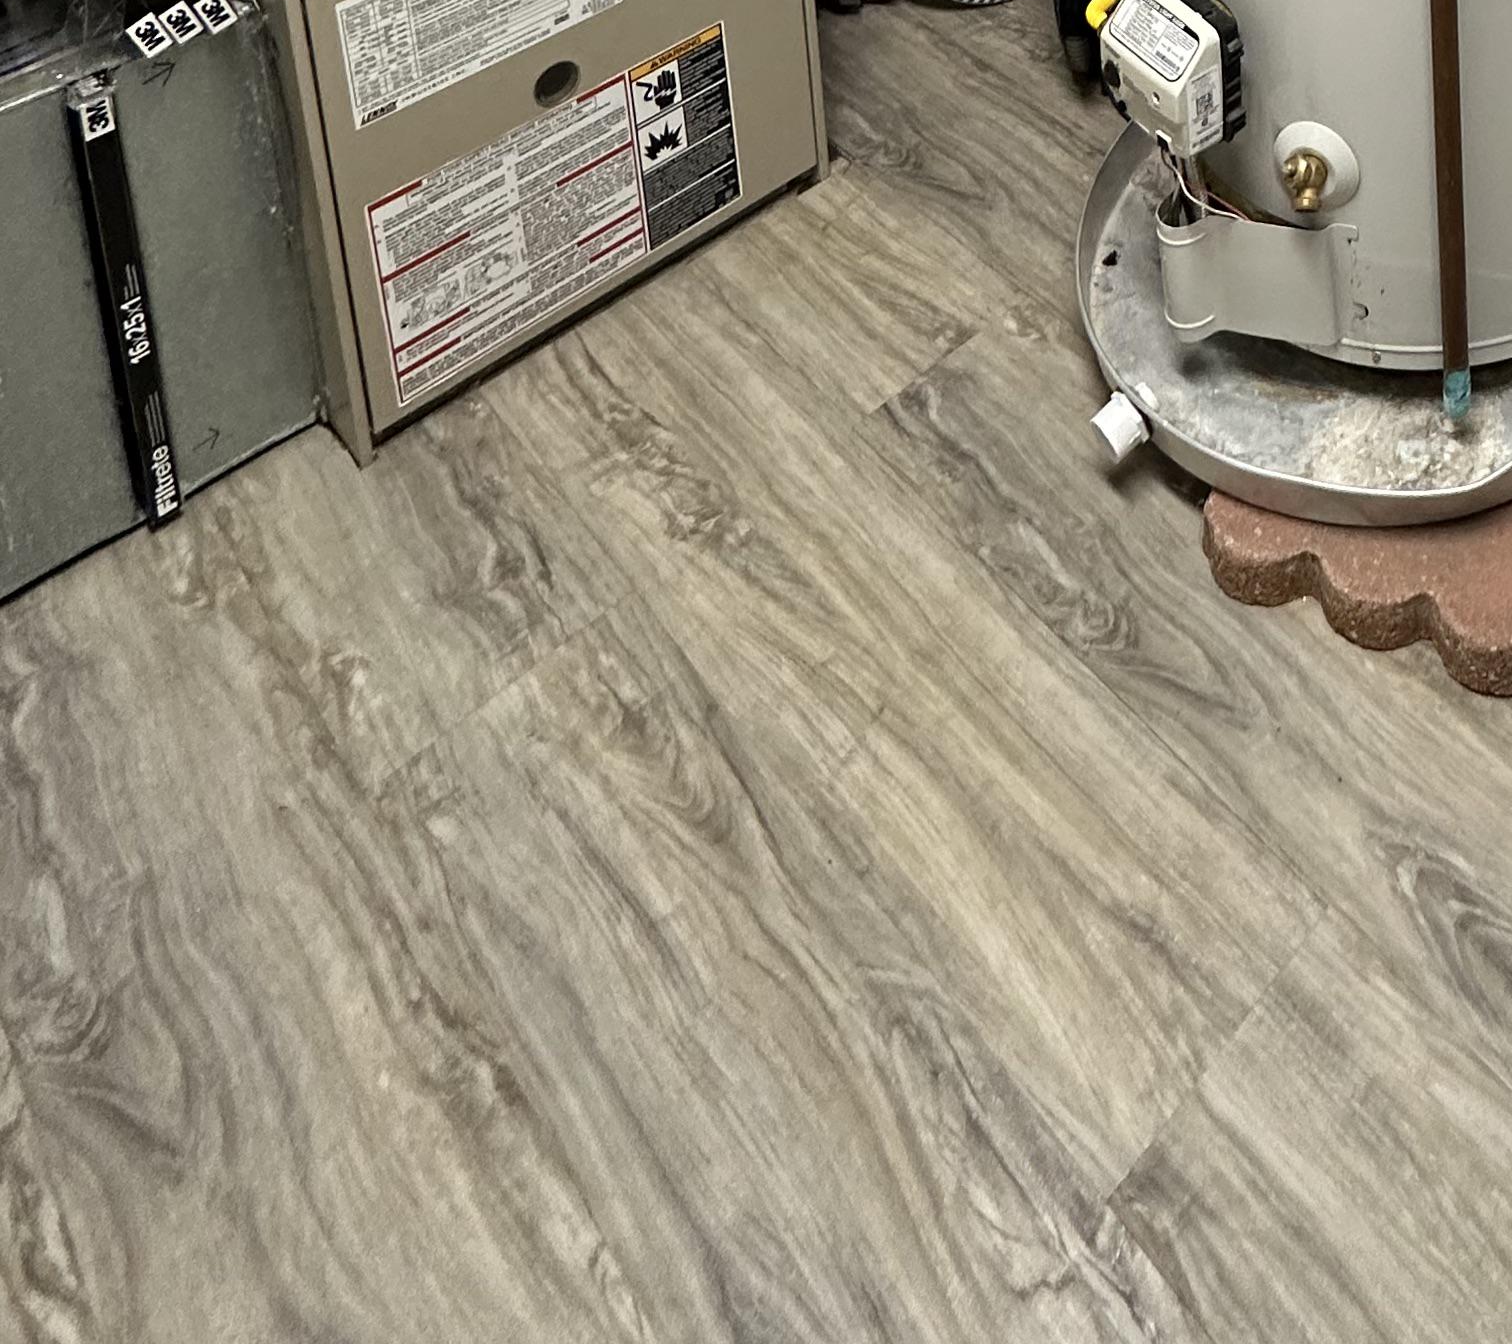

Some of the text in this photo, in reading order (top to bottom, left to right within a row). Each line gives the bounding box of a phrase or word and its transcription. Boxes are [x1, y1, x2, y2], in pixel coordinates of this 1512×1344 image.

[135, 20, 166, 52] 3M
[166, 8, 198, 37] 3M
[659, 36, 702, 64] WARNING
[87, 96, 109, 134] 3M
[119, 294, 151, 365] 16x25x1
[151, 444, 179, 518] Filtrete
